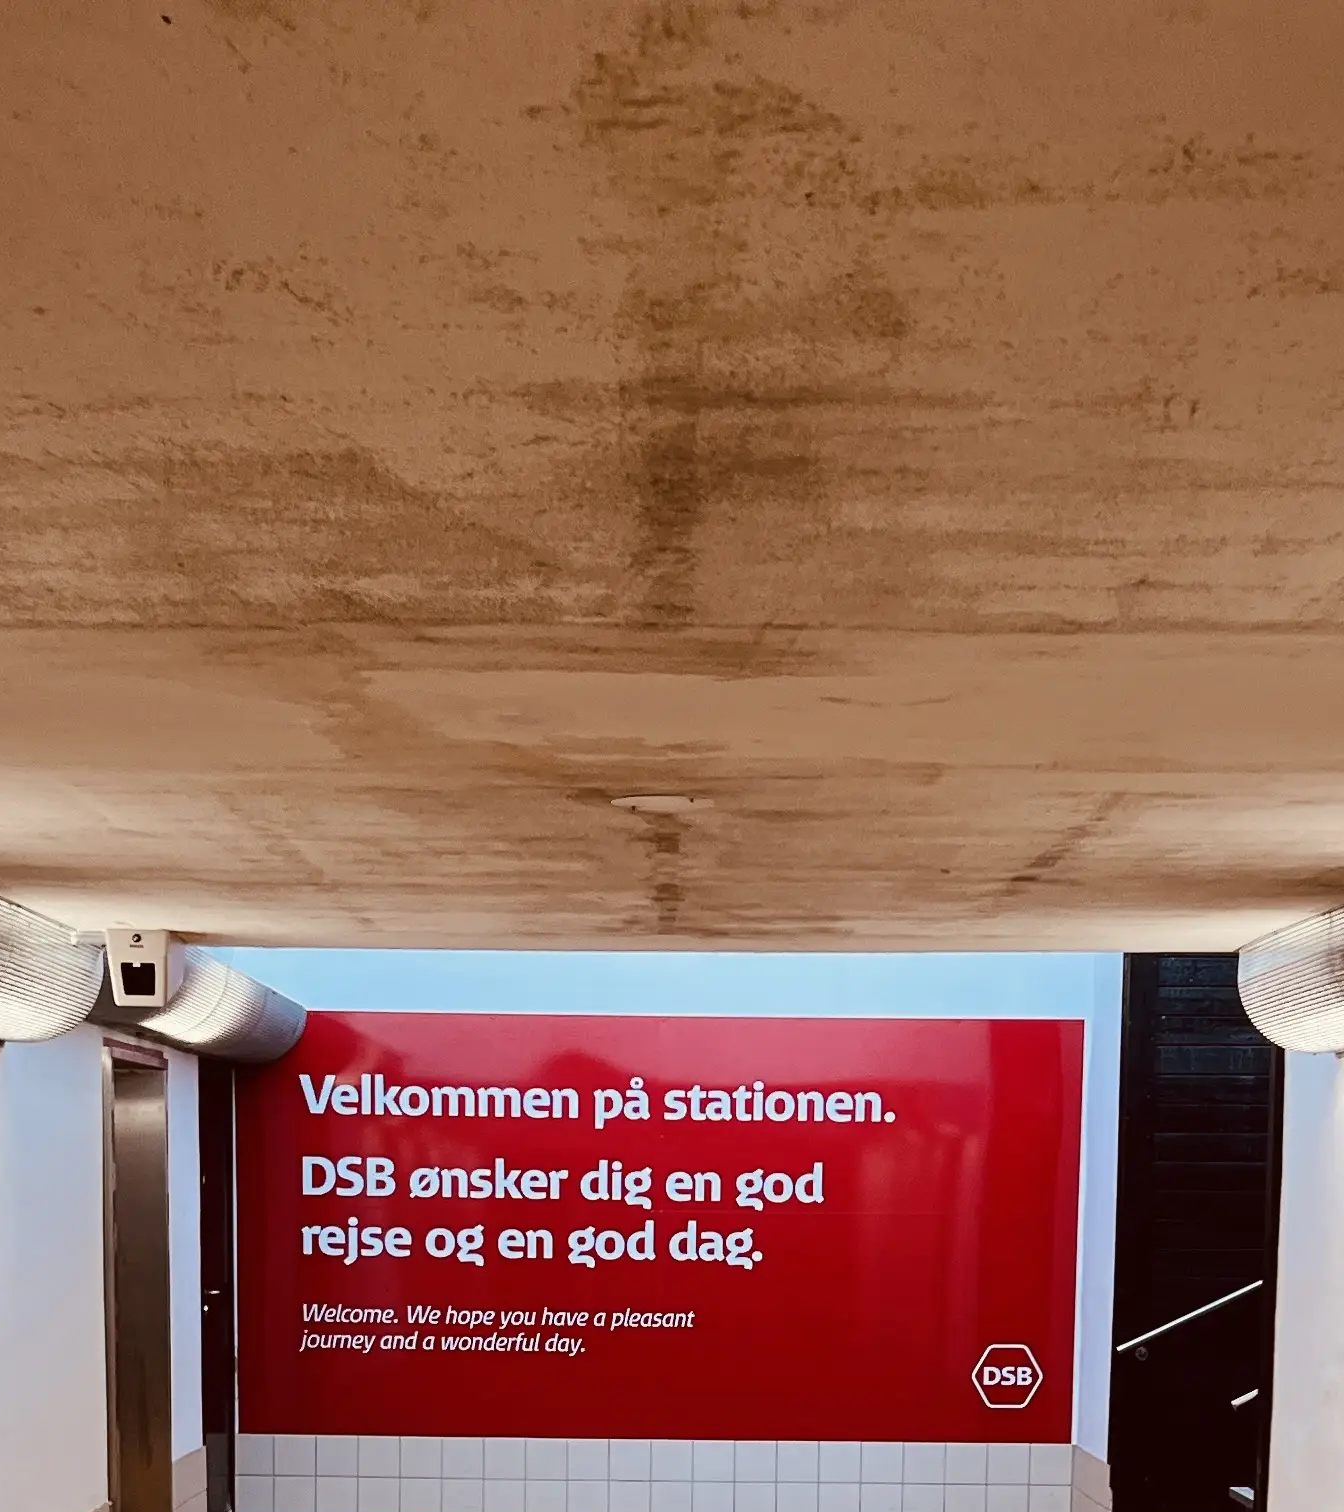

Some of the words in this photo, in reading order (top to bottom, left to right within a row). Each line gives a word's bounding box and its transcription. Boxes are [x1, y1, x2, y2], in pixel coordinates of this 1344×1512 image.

[298, 1074, 579, 1119] Velkommen
[593, 1076, 651, 1130] på
[663, 1080, 896, 1123] stationen.
[302, 1156, 396, 1197] DSB
[409, 1158, 569, 1200] ønsker
[580, 1159, 653, 1210] dig
[665, 1171, 722, 1202] en
[735, 1161, 825, 1212] god
[301, 1216, 413, 1266] rejse
[425, 1224, 485, 1267] og
[497, 1228, 553, 1259] en
[567, 1219, 657, 1269] god
[668, 1220, 763, 1271] dag.
[302, 1303, 399, 1324] Welcome.
[407, 1305, 442, 1325] We
[445, 1305, 496, 1330] hope
[499, 1310, 537, 1329] you
[540, 1306, 590, 1328] have
[593, 1311, 607, 1327] a
[610, 1307, 696, 1332] pleasant
[299, 1329, 377, 1354] journey
[380, 1330, 419, 1351] and
[422, 1335, 436, 1351] a
[441, 1331, 541, 1352] wonderful
[544, 1332, 586, 1357] day.
[983, 1366, 1033, 1386] DSB
